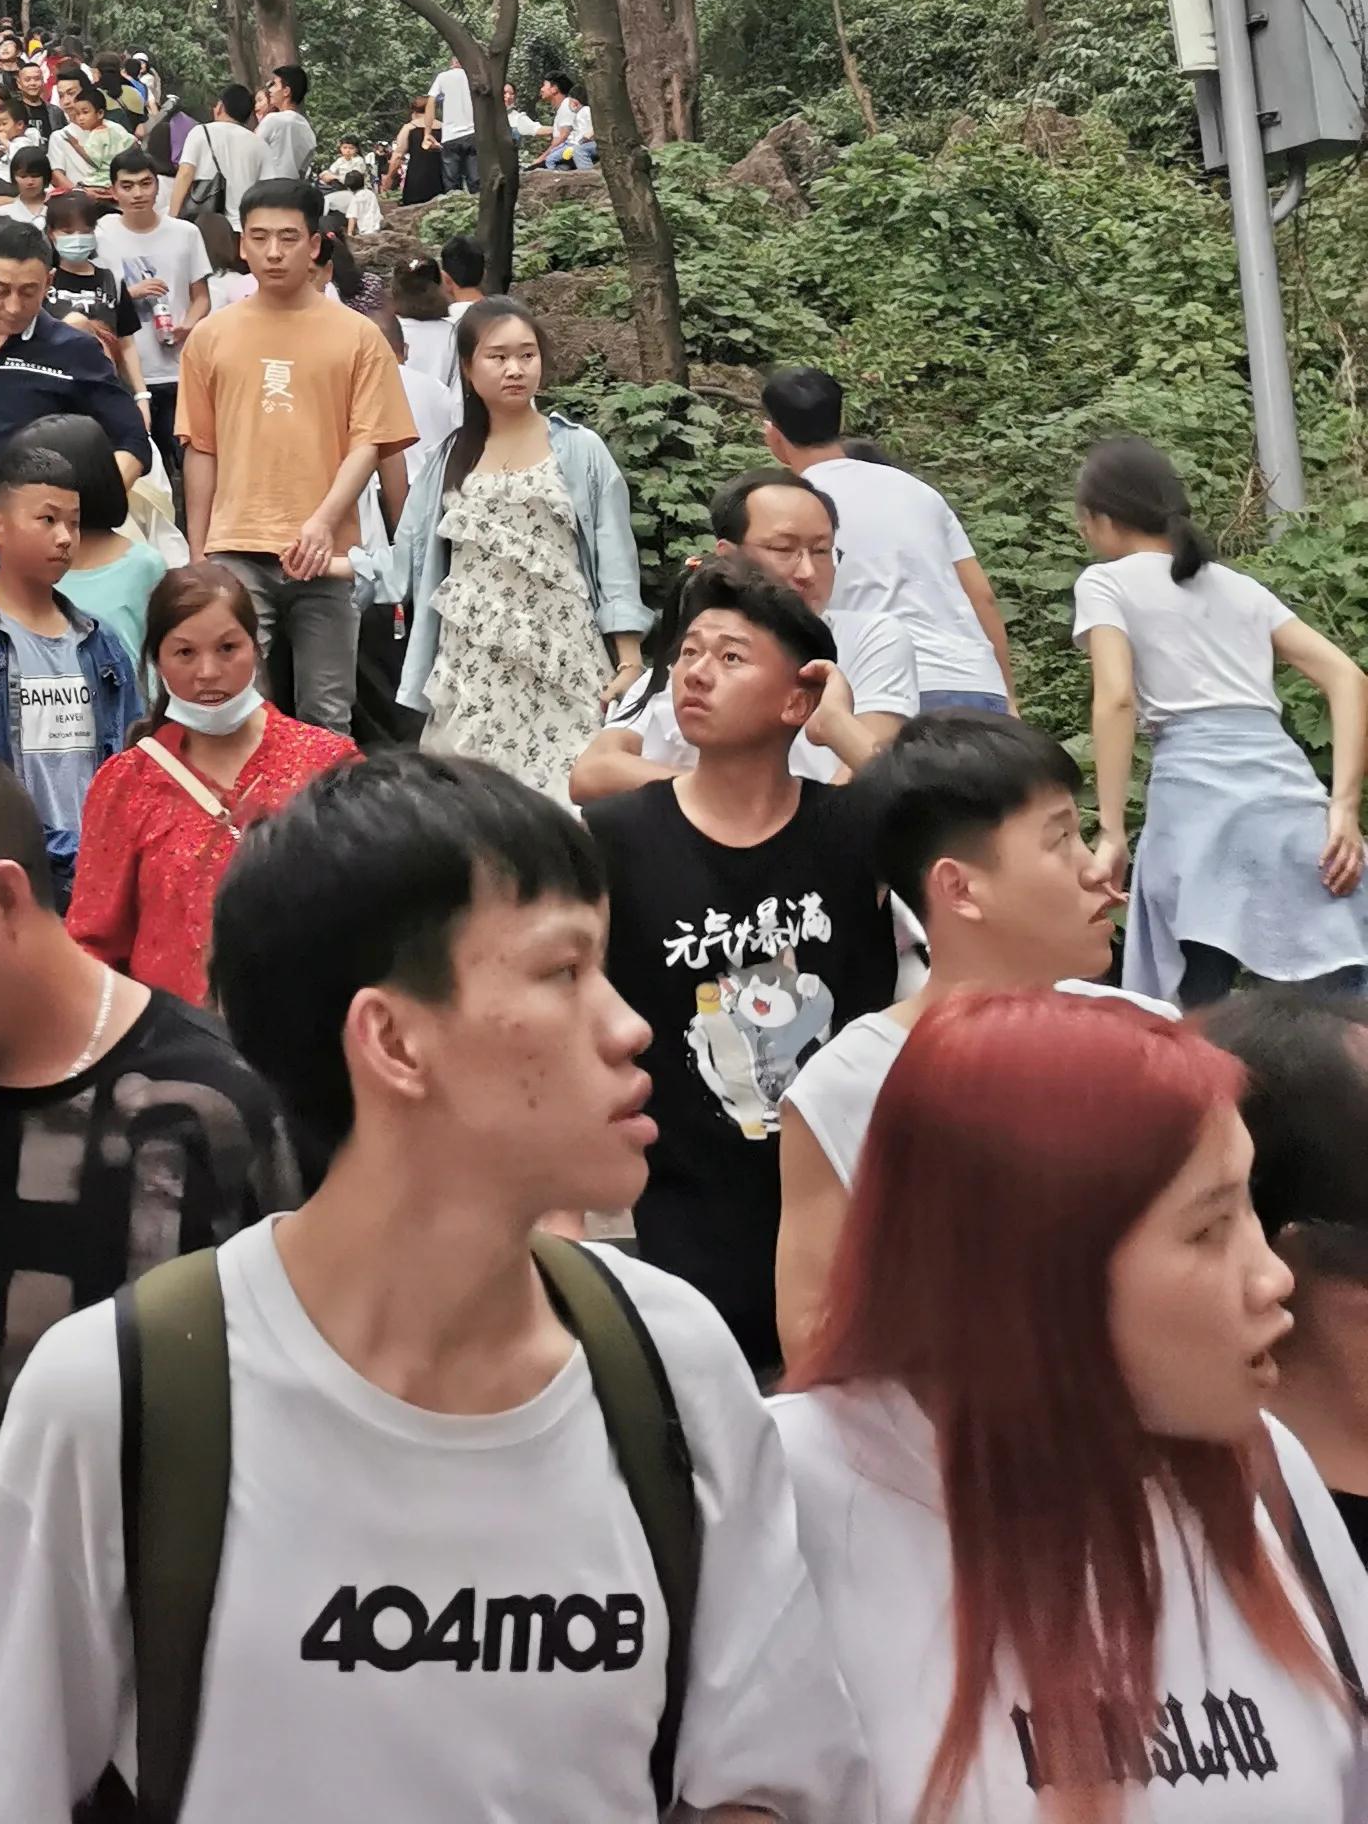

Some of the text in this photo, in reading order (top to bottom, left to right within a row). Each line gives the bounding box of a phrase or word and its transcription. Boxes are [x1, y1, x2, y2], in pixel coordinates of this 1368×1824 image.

[259, 358, 295, 398] 夏
[20, 686, 91, 707] BAHAVIO
[662, 891, 832, 970] 元气爆满
